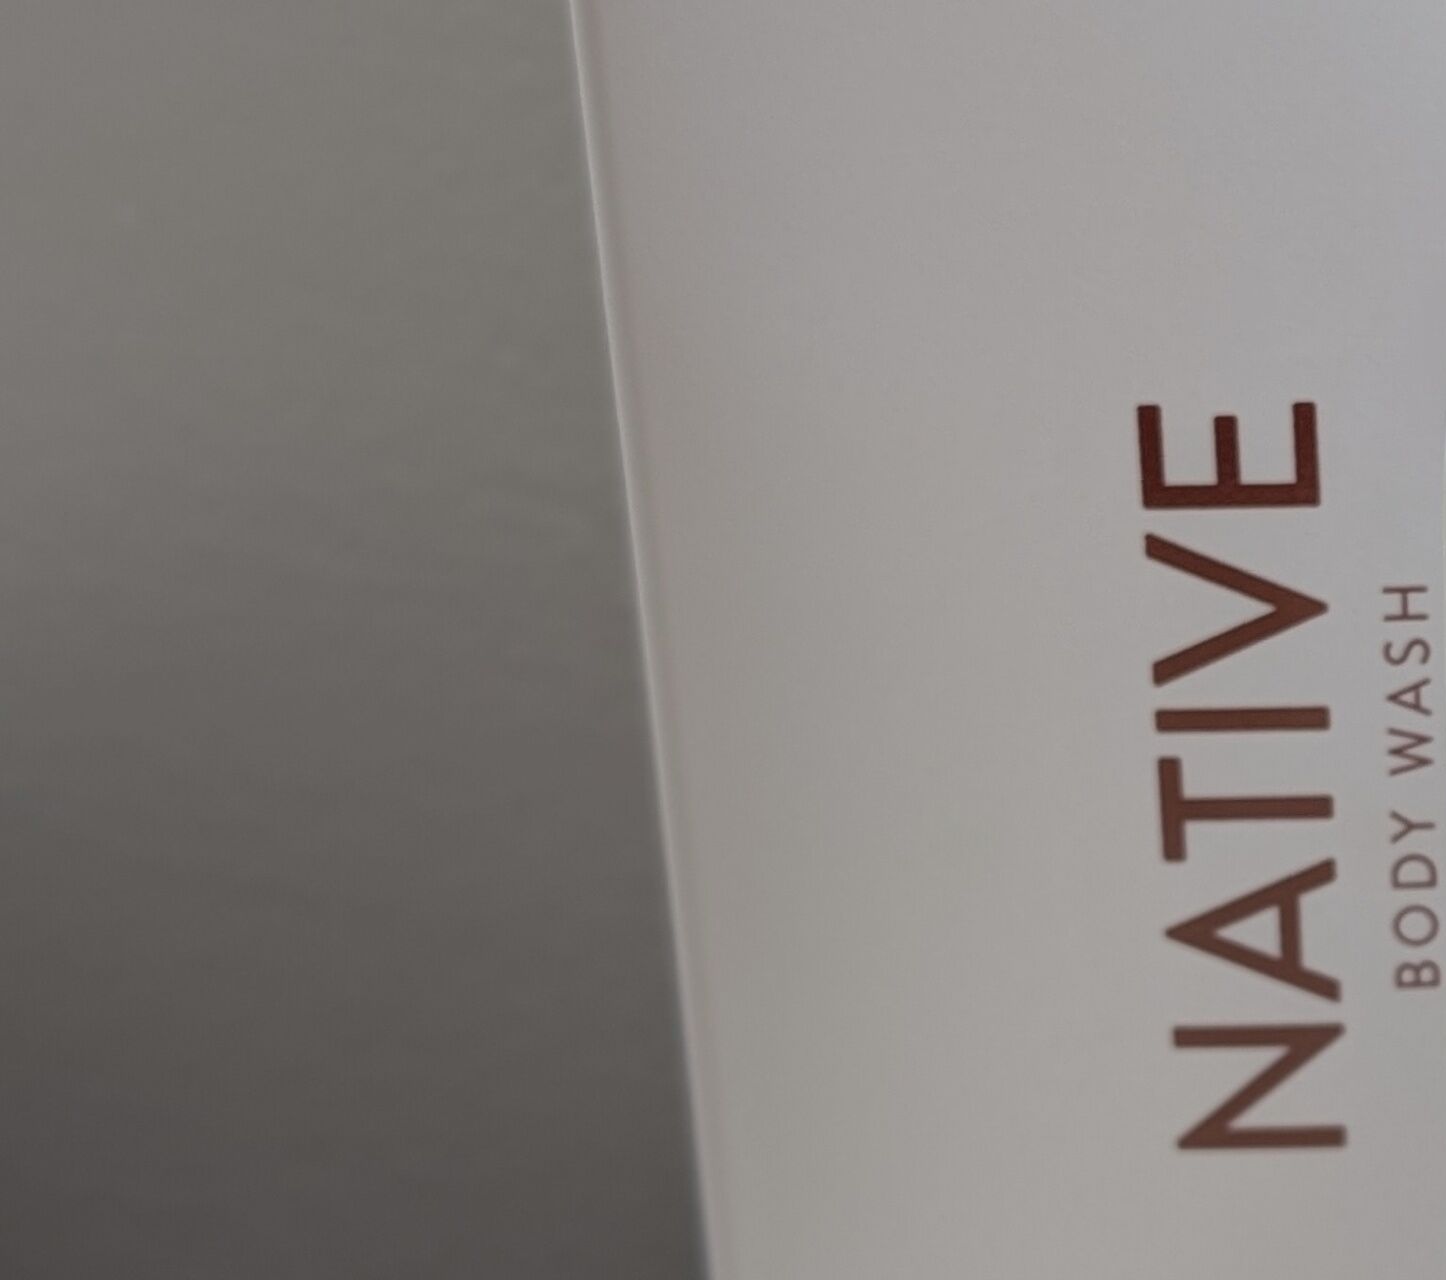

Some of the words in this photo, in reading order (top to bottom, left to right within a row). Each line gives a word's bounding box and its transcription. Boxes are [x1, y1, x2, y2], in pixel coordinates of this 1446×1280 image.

[1137, 401, 1347, 1150] NATIVE
[1382, 585, 1434, 777] WASH
[1390, 810, 1442, 990] BODY
